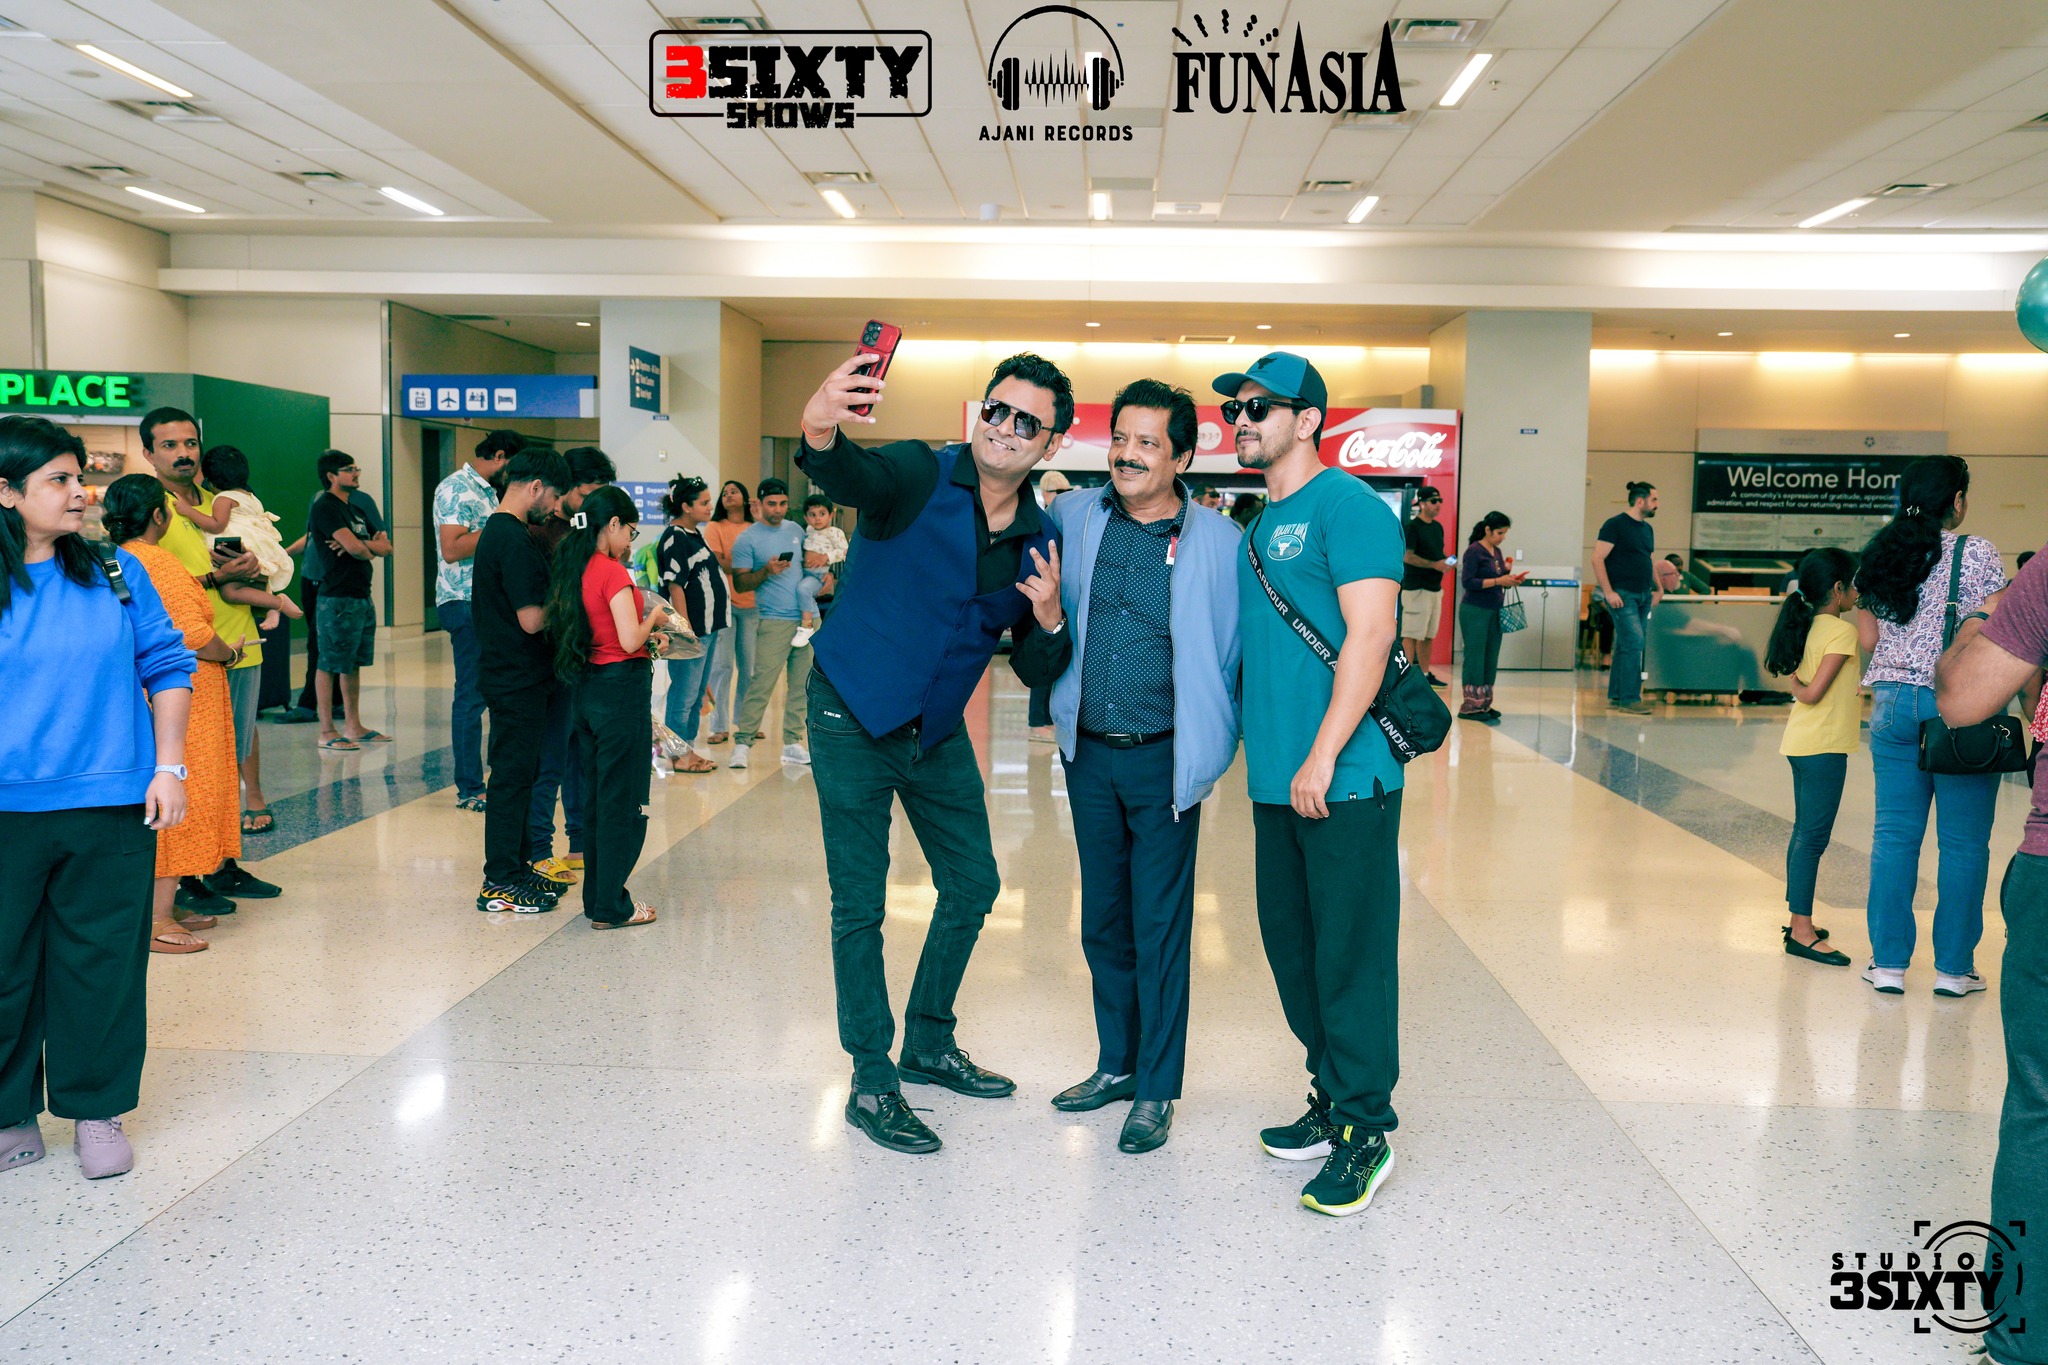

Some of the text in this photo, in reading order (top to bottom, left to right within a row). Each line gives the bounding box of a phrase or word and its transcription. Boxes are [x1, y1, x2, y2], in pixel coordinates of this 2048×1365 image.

[0, 373, 131, 408] PLACE
[1727, 465, 1901, 489] Welcome Hom
[1740, 491, 1781, 500] community's
[1782, 492, 1819, 501] expression
[1820, 492, 1828, 500] of
[1759, 500, 1784, 509] respect
[1810, 501, 1840, 510] returning
[1256, 568, 1289, 616] ARMOUR
[1292, 618, 1331, 660] UNDER
[1380, 716, 1410, 751] UNDE
